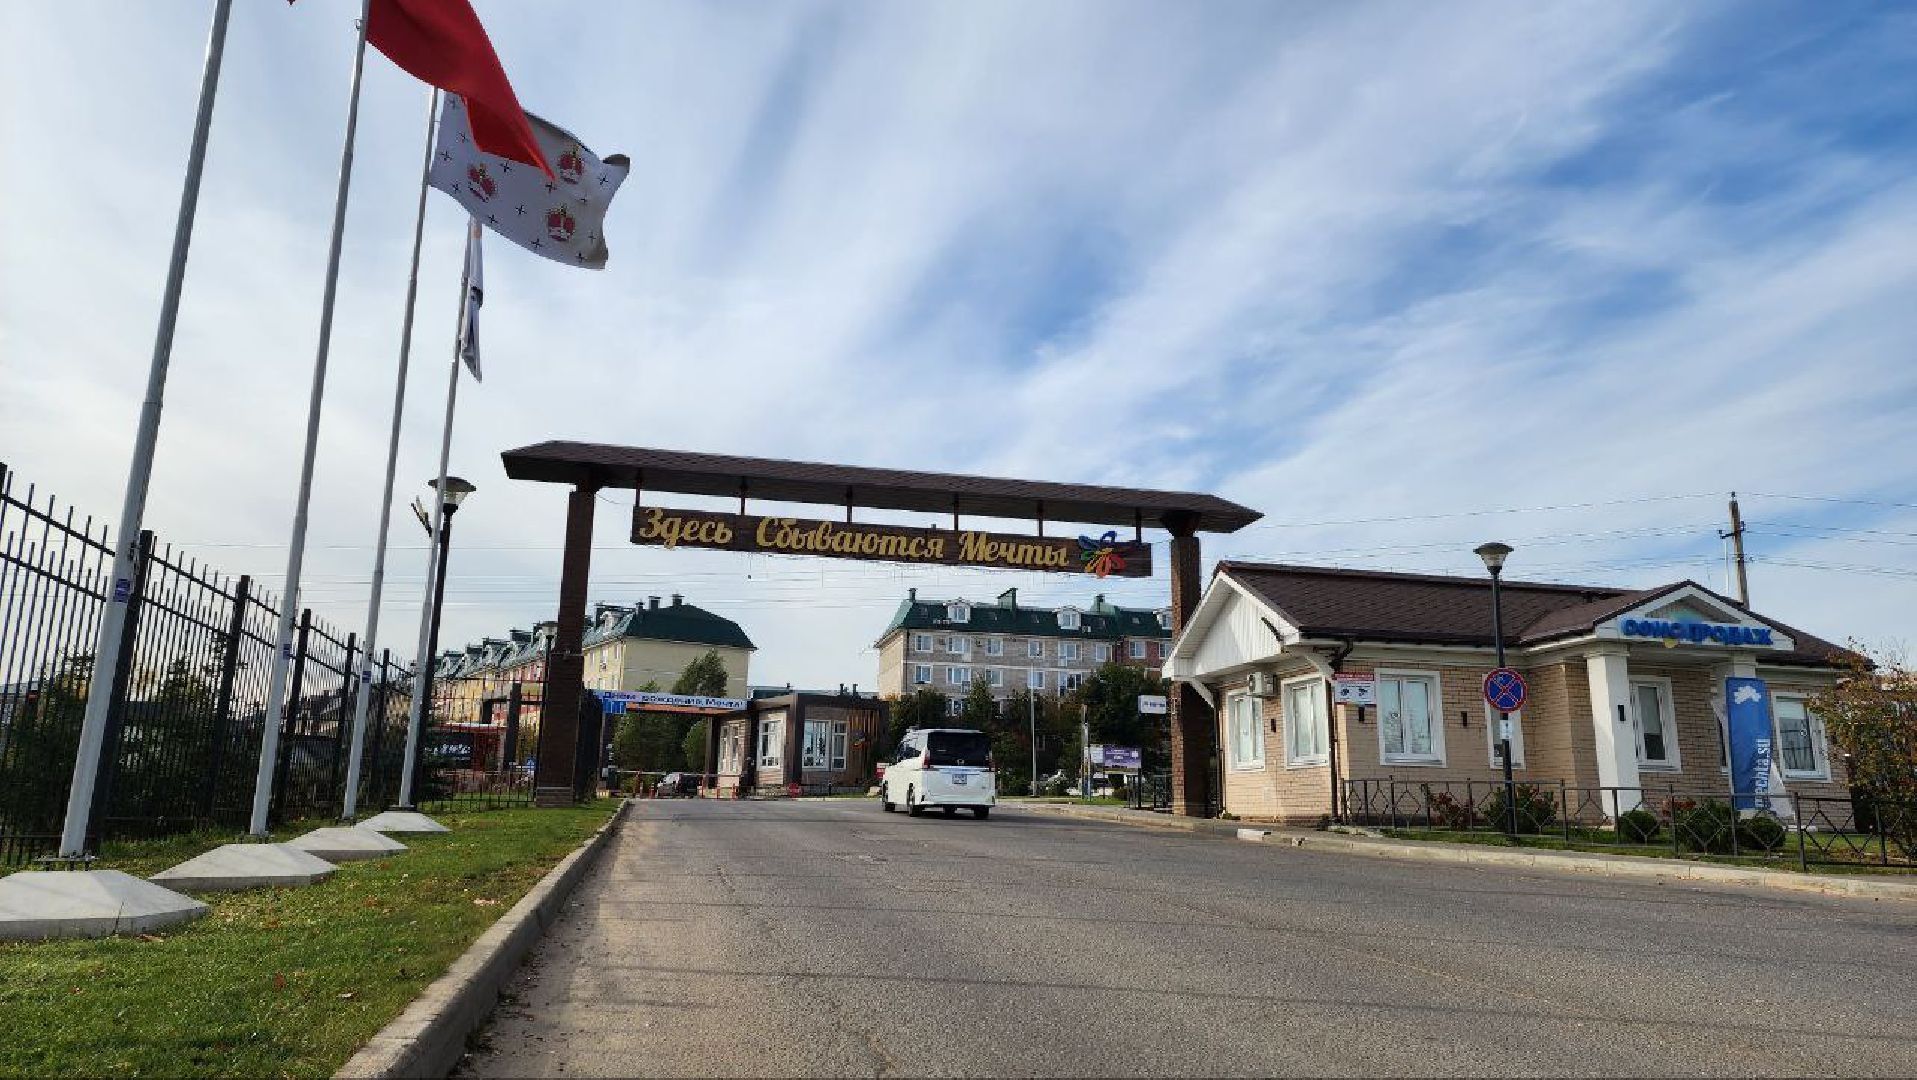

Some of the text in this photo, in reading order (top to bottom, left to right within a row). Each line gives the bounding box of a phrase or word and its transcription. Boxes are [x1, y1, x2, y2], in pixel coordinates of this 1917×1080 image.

[640, 507, 1070, 567] Здесь Сбываются Мечты
[1687, 623, 1774, 646] ПРОДАЖ
